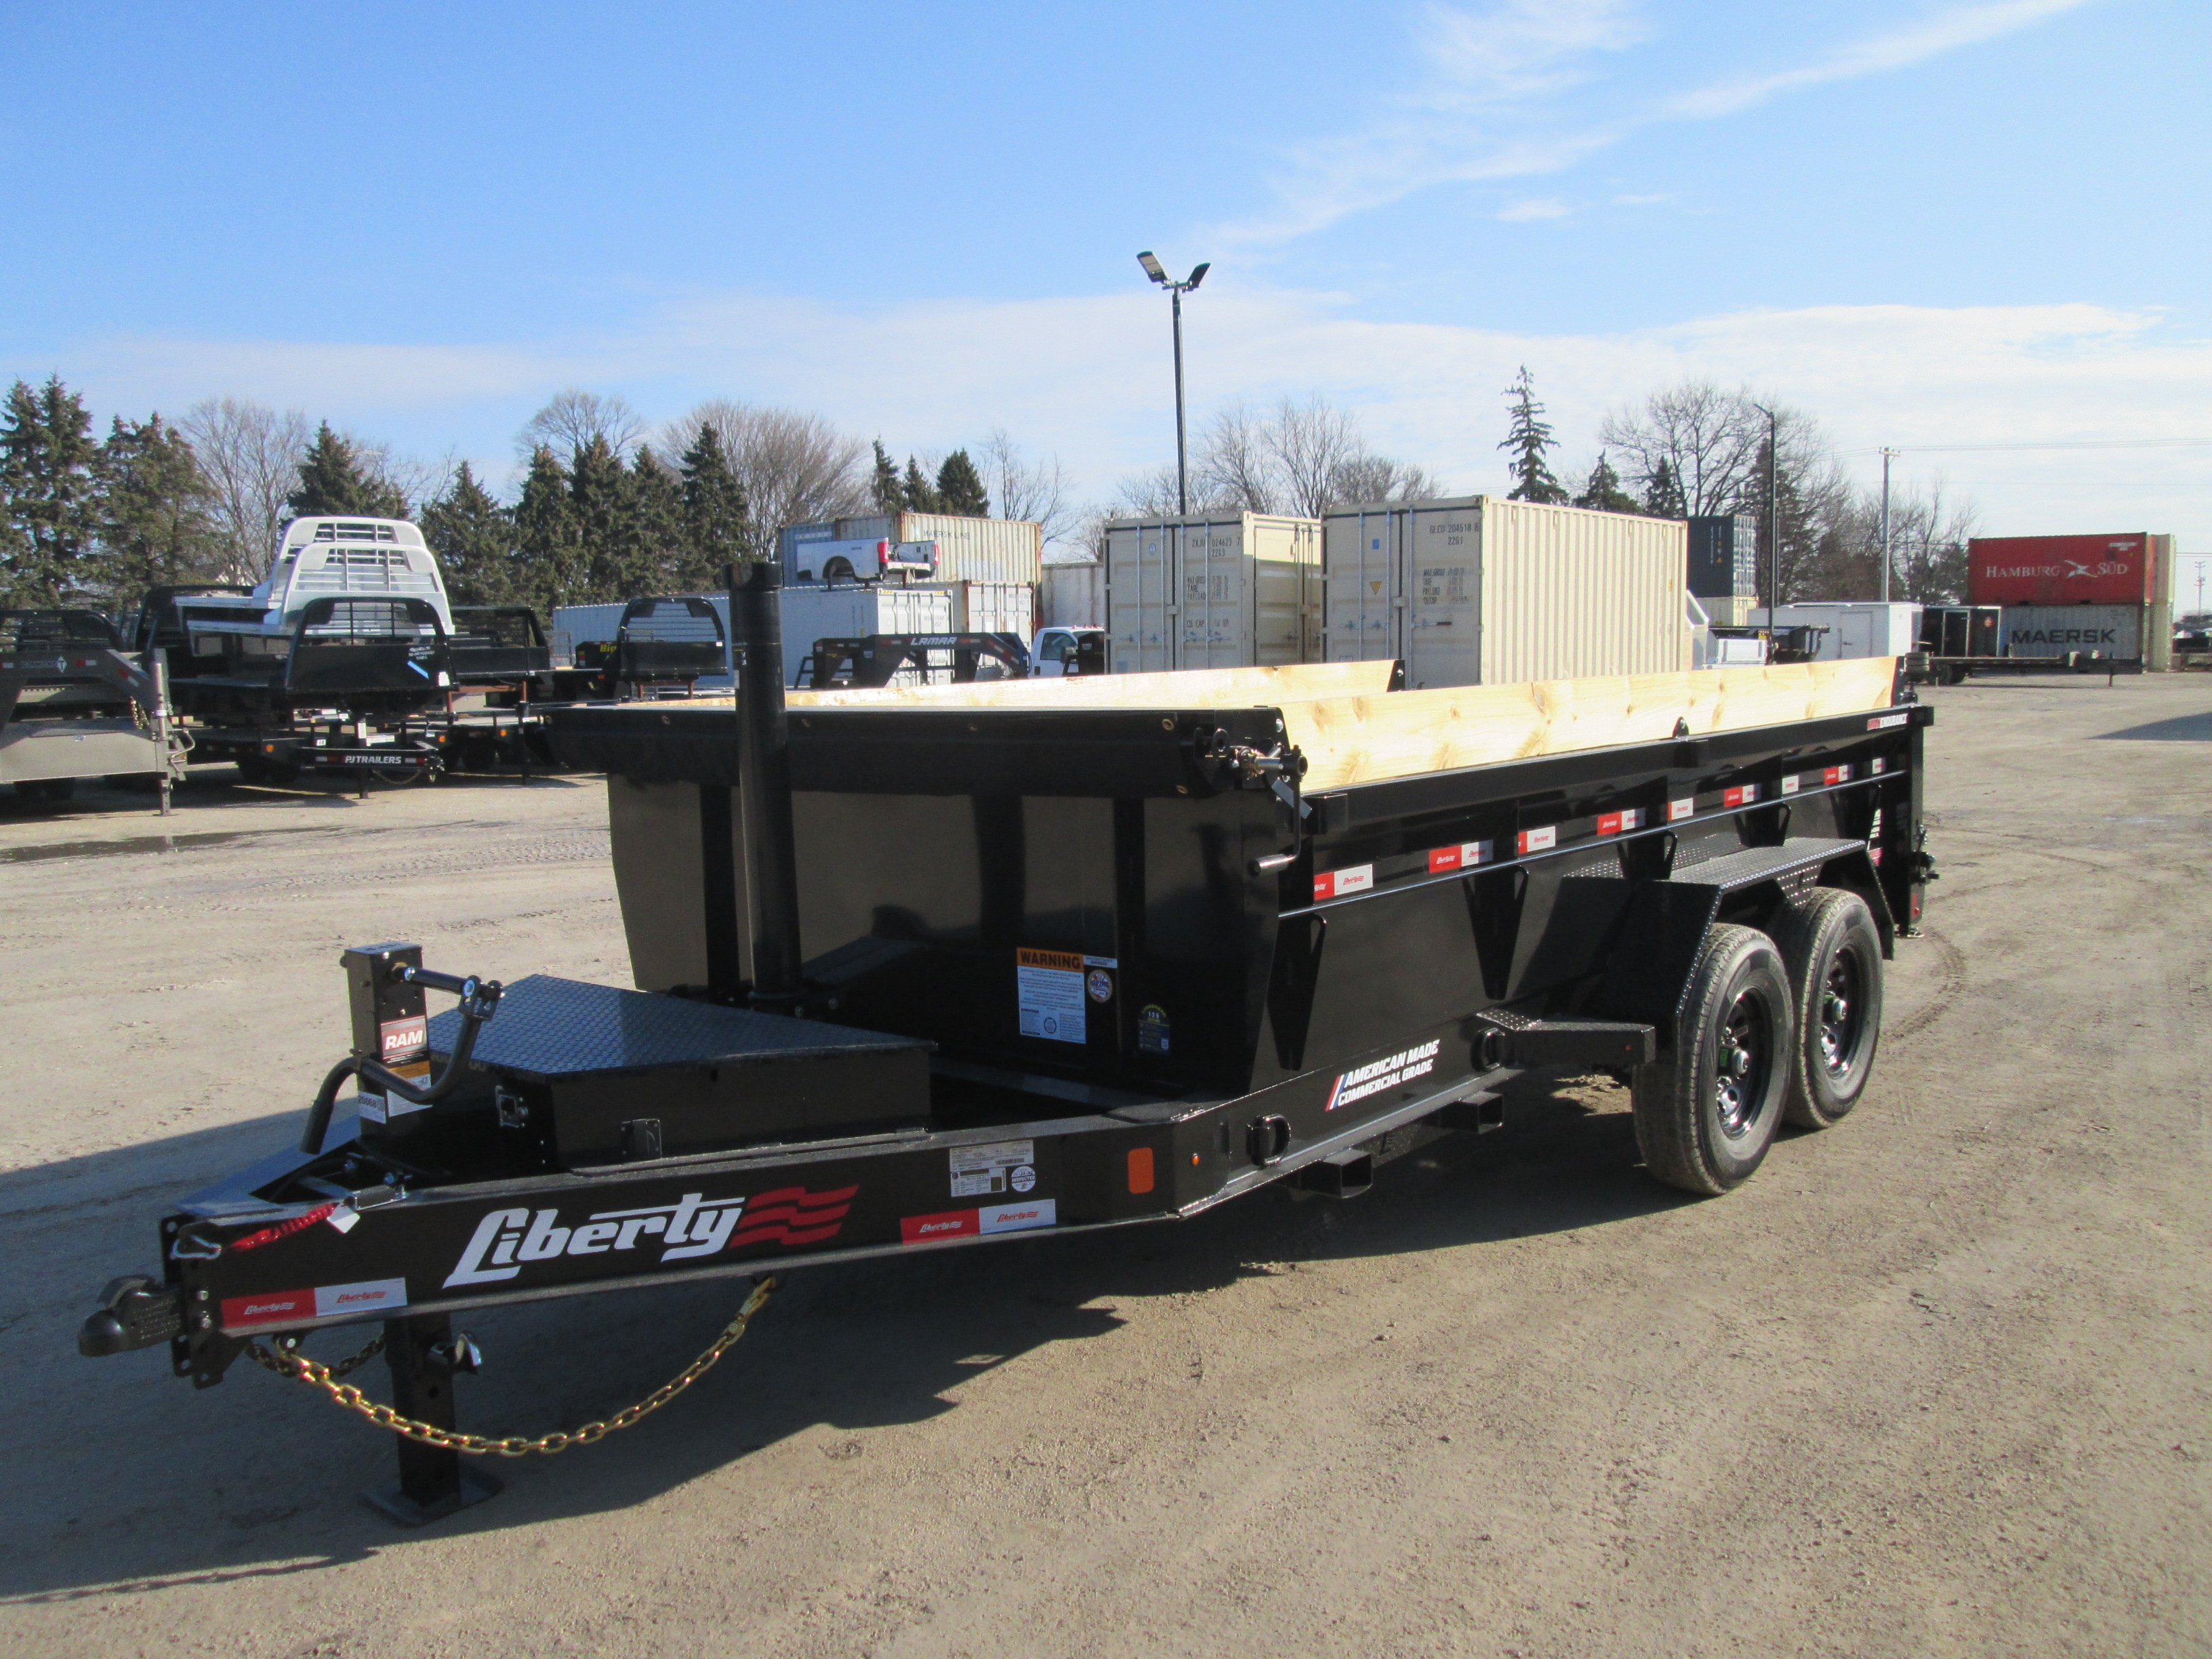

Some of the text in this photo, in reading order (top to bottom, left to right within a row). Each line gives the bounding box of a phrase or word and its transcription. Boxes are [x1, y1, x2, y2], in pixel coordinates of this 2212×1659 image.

[923, 530, 953, 538] MAERSK
[1448, 523, 1471, 533] 204518
[1212, 537, 1232, 547] 024623
[1985, 561, 2128, 577] HAMBURG SÜD
[910, 636, 957, 646] LAMAR
[2011, 628, 2116, 644] MAERSK
[1020, 951, 1081, 970] WARNING
[385, 1029, 424, 1050] RAM
[1344, 1039, 1440, 1088] AMERICAN MADE
[1338, 1059, 1433, 1107] COMMERCIAL GRADE
[443, 1192, 745, 1289] Liberty
